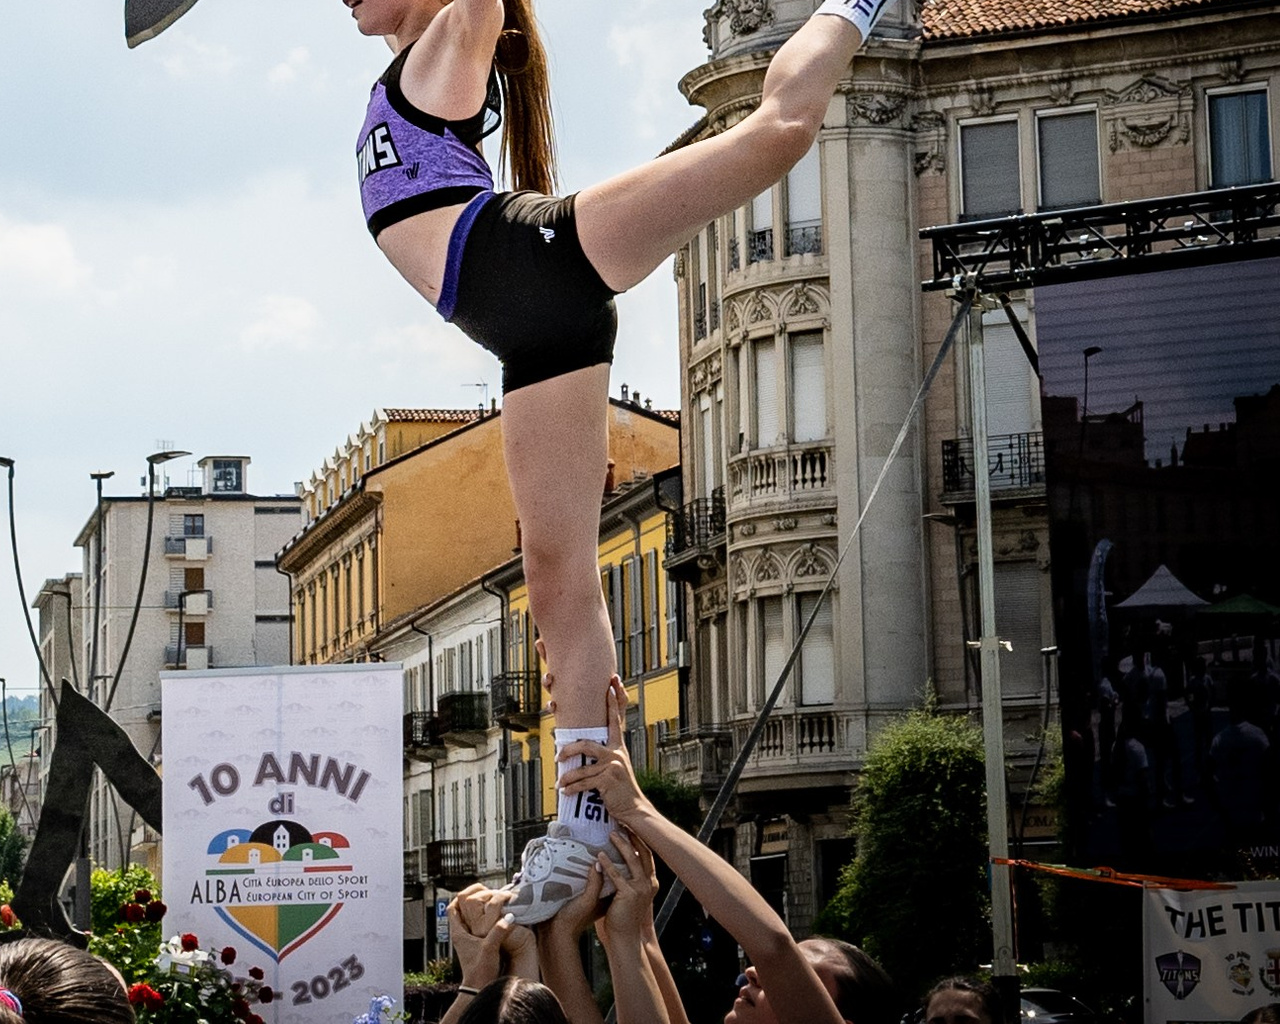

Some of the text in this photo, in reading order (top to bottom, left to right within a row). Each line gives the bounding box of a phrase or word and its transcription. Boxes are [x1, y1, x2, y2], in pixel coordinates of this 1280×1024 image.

[187, 751, 372, 806] 10 ANNI
[268, 792, 295, 814] di
[190, 879, 242, 904] ALBA
[1164, 905, 1226, 938] THE
[290, 953, 365, 1006] 2023
